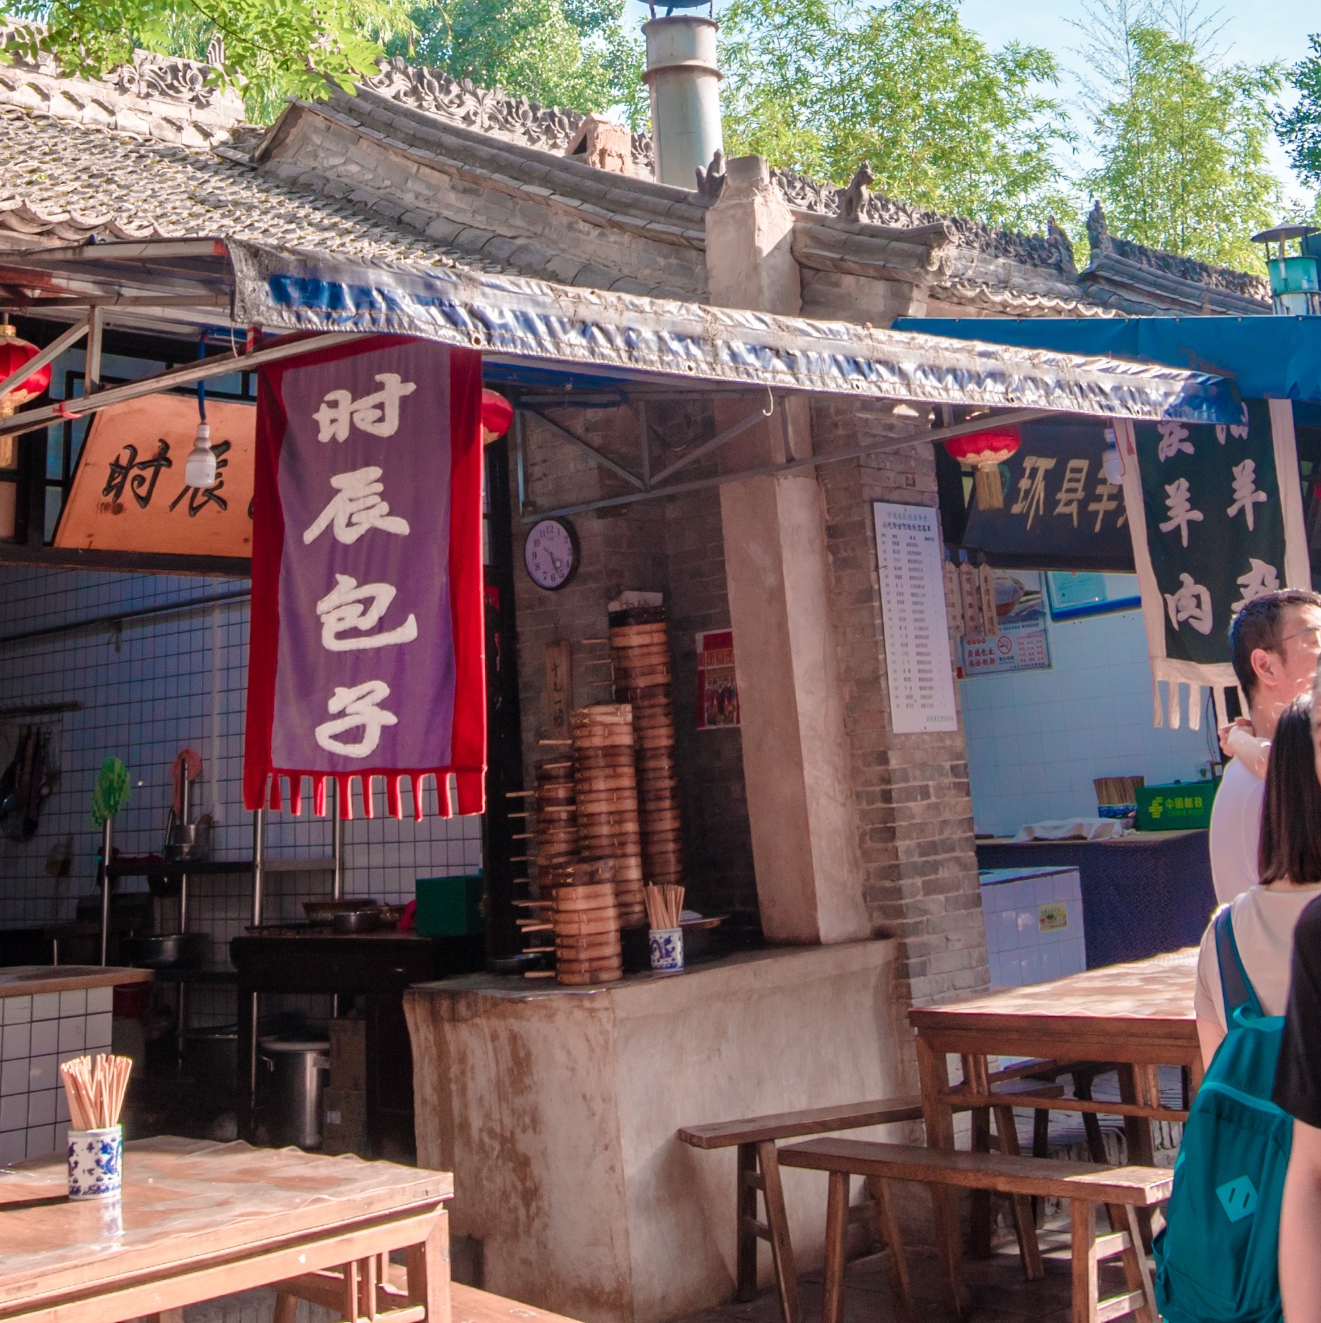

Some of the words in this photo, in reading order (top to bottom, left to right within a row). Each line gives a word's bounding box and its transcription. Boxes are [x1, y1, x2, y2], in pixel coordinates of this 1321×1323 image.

[102, 439, 254, 519] 时辰
[1011, 456, 1128, 533] 环县羊
[304, 373, 416, 758] 时辰包子
